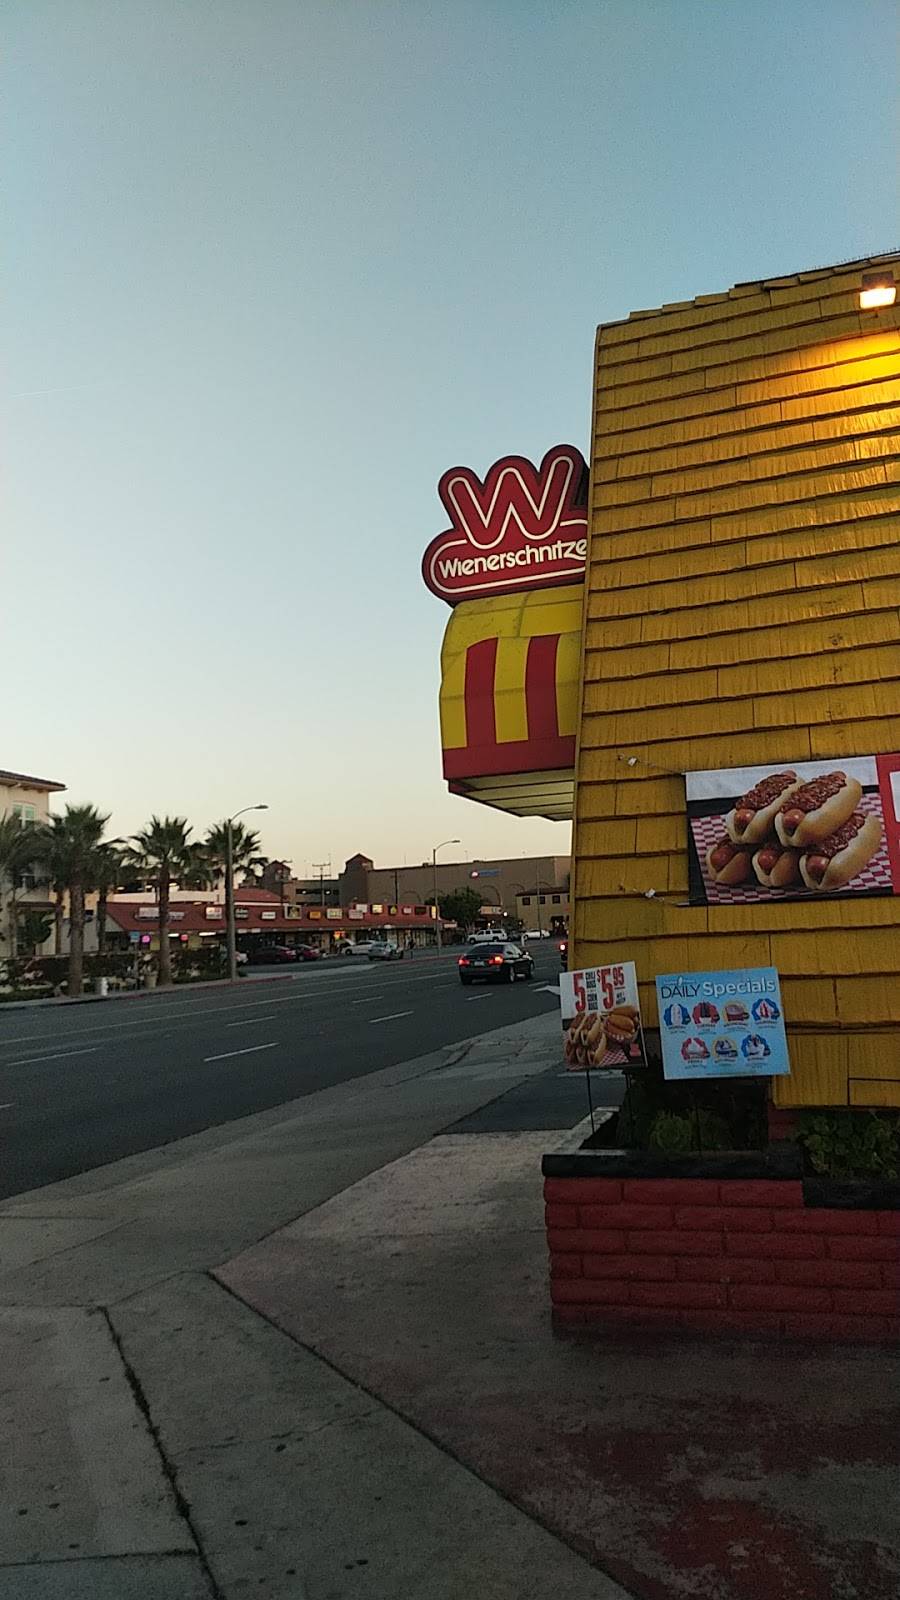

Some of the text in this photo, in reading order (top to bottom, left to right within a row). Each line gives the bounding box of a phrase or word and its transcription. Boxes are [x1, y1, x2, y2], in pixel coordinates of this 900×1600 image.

[573, 973, 586, 1012] 5
[661, 977, 776, 999] DAILY Specials
